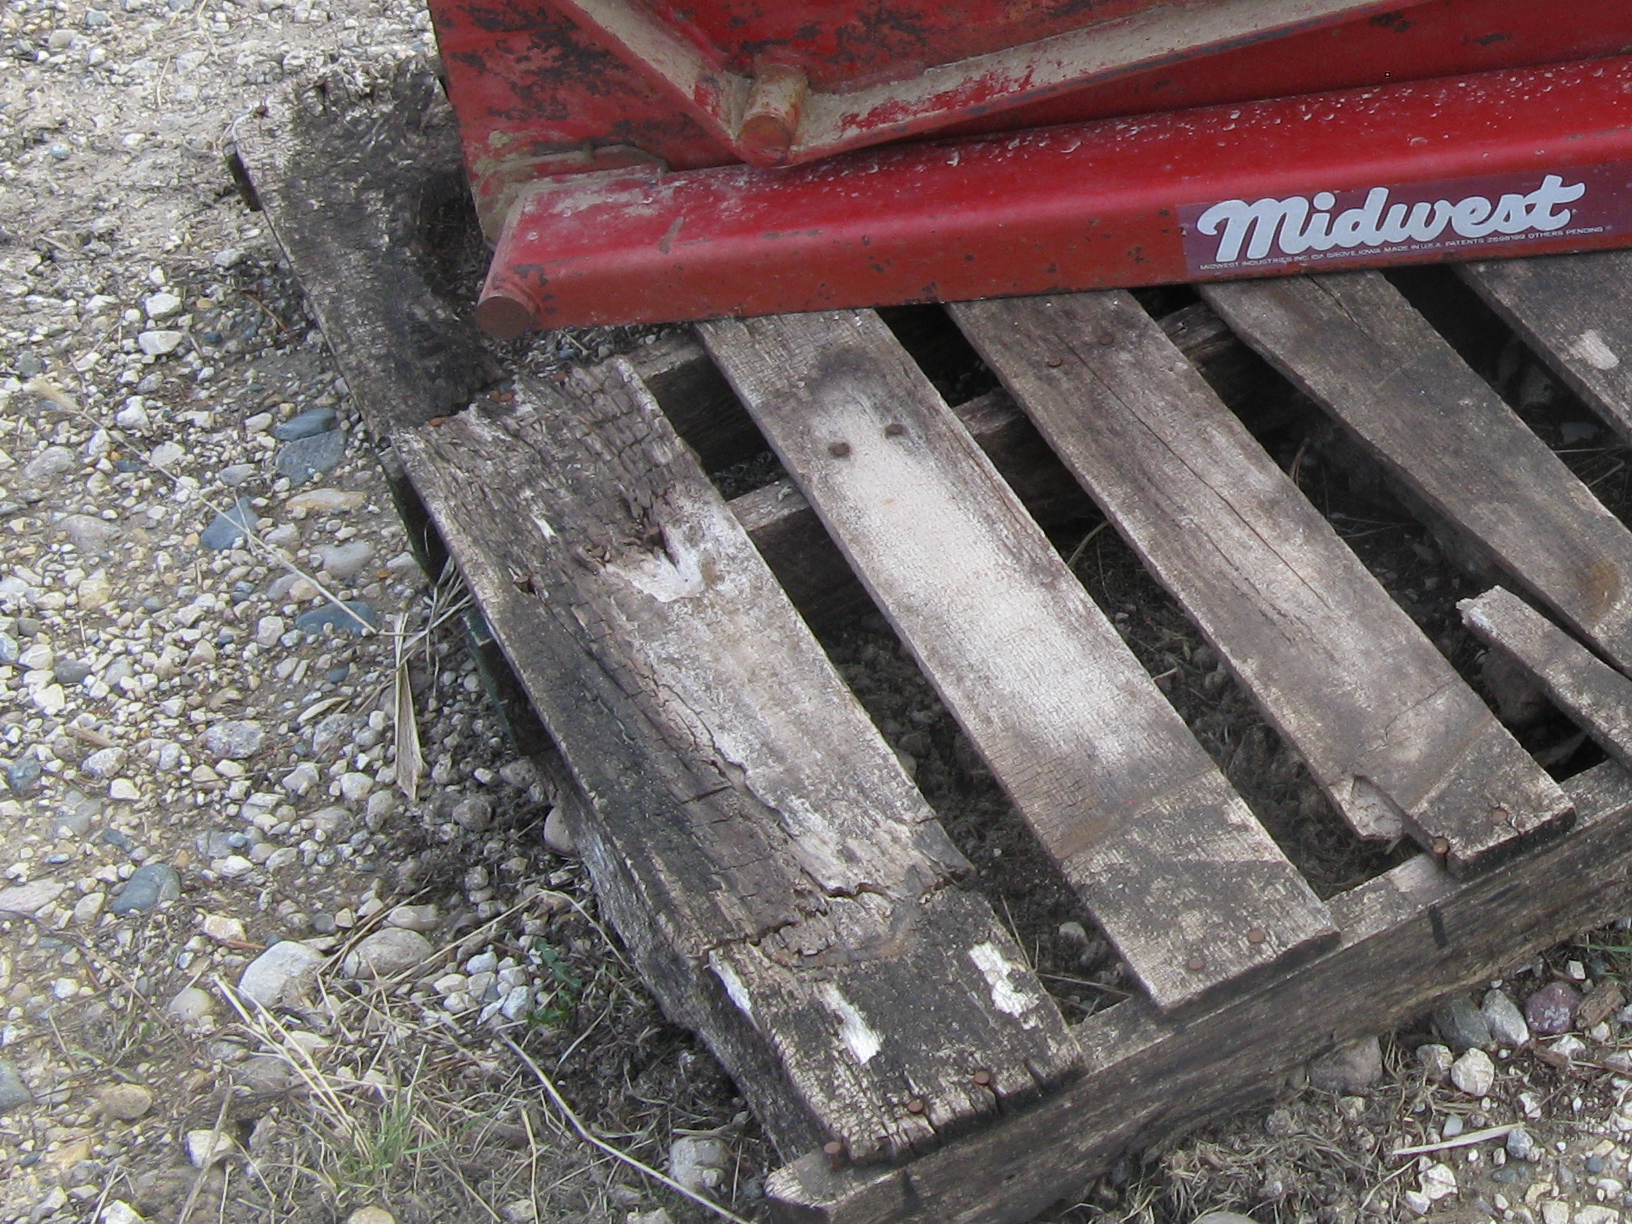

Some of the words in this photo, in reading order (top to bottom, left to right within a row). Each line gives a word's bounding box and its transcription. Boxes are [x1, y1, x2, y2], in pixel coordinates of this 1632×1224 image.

[1197, 174, 1586, 263] Midwest
[1528, 230, 1563, 239] OTHERS
[1566, 226, 1603, 236] PENDING
